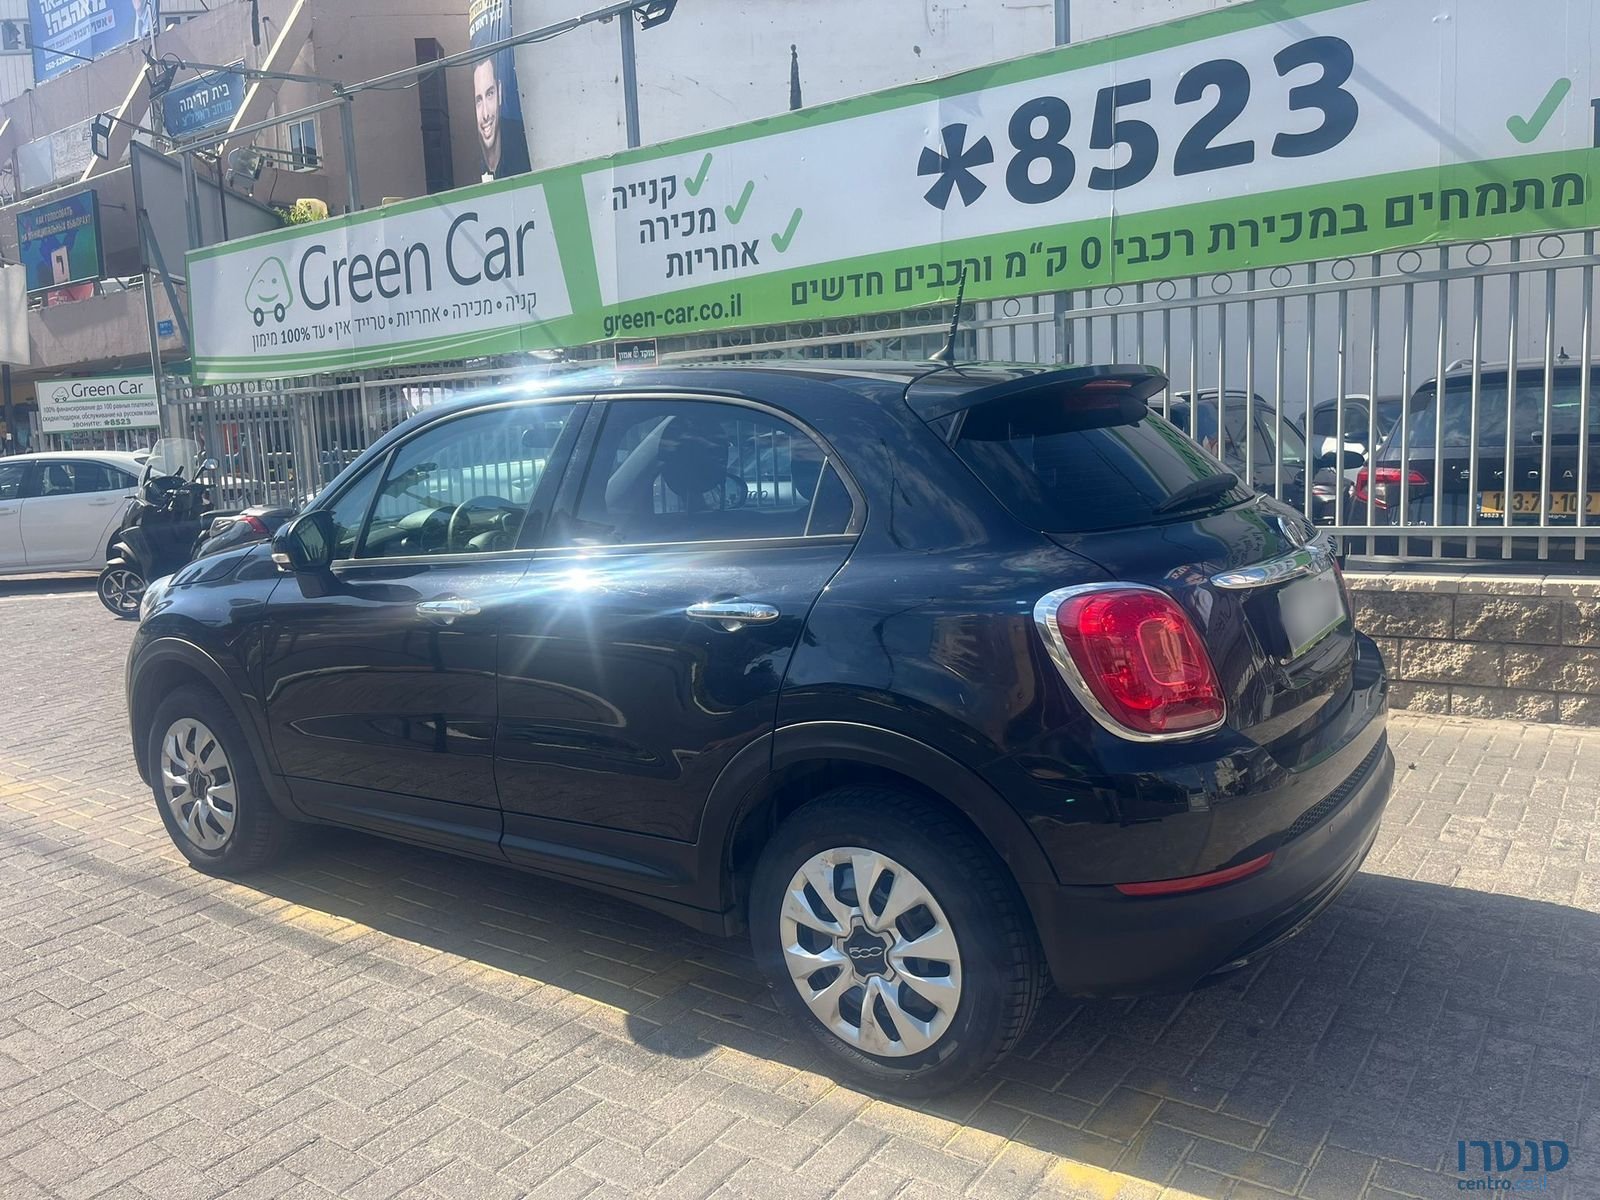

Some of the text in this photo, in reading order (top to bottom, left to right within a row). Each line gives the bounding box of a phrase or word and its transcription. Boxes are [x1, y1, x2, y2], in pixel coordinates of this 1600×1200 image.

[179, 83, 230, 112] בית קדימה
[612, 174, 677, 211] קנייה
[1385, 173, 1585, 228] מתמחים
[639, 207, 716, 244] מכירה
[1207, 202, 1368, 254] במכירת
[299, 211, 535, 311] Green Car
[666, 239, 760, 278] אחריות
[1080, 236, 1101, 270] 0
[1113, 228, 1194, 265] רכבי
[791, 271, 883, 306] חדשים
[895, 255, 992, 292] ורכבים
[251, 293, 538, 352] קניה מכירה אחריות טרייד אין עד 100% מימון
[603, 293, 742, 338] green-car.co.il
[71, 380, 144, 398] Green Car
[849, 946, 883, 959] 500
